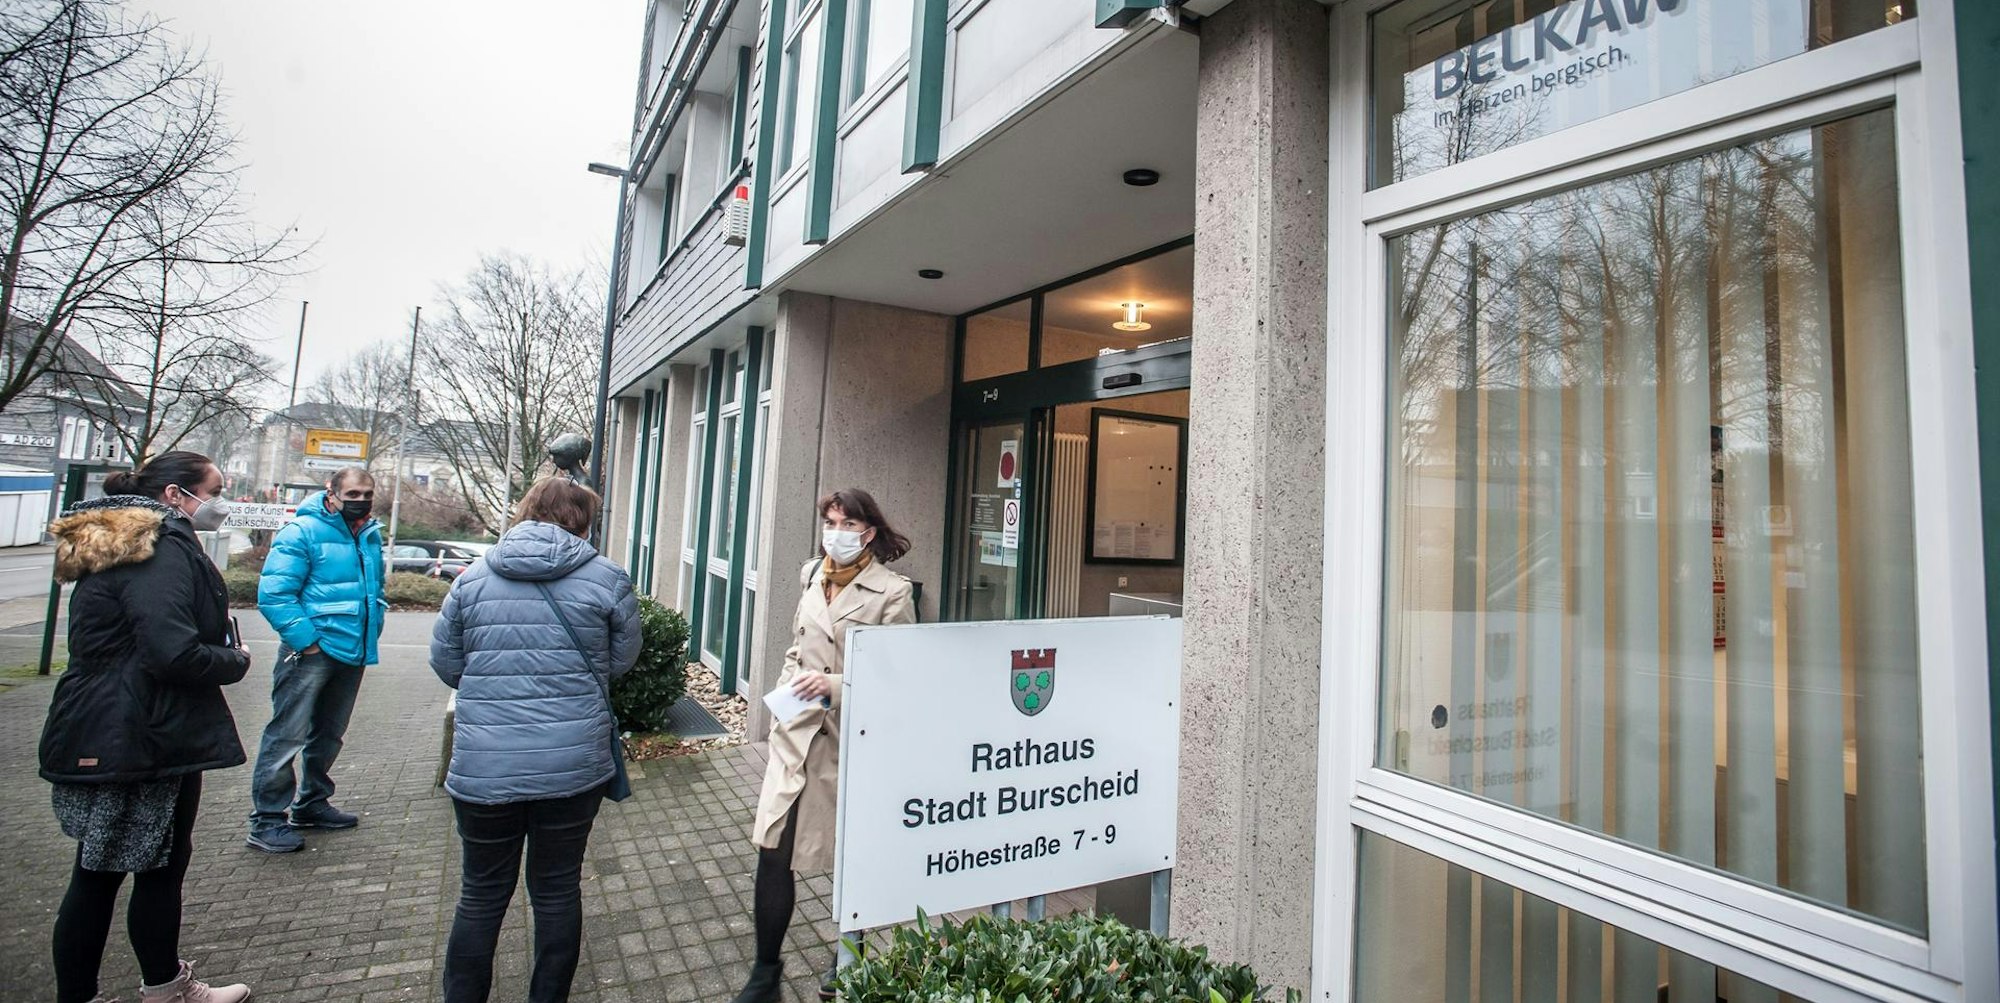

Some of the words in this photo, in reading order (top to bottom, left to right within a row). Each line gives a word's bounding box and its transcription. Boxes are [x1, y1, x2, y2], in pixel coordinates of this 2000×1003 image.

[1434, 110, 1453, 128] Im
[1459, 83, 1525, 117] Herzen
[1532, 45, 1628, 92] bergisch.
[223, 517, 279, 528] Musikschule
[244, 505, 258, 514] der
[260, 505, 284, 516] Kunst
[972, 737, 1095, 773] Rathaus
[902, 791, 987, 828] Stadt
[998, 769, 1139, 815] Burscheid
[926, 835, 1061, 876] Höhestraße
[1073, 829, 1085, 850] 7
[1104, 824, 1116, 844] 9
